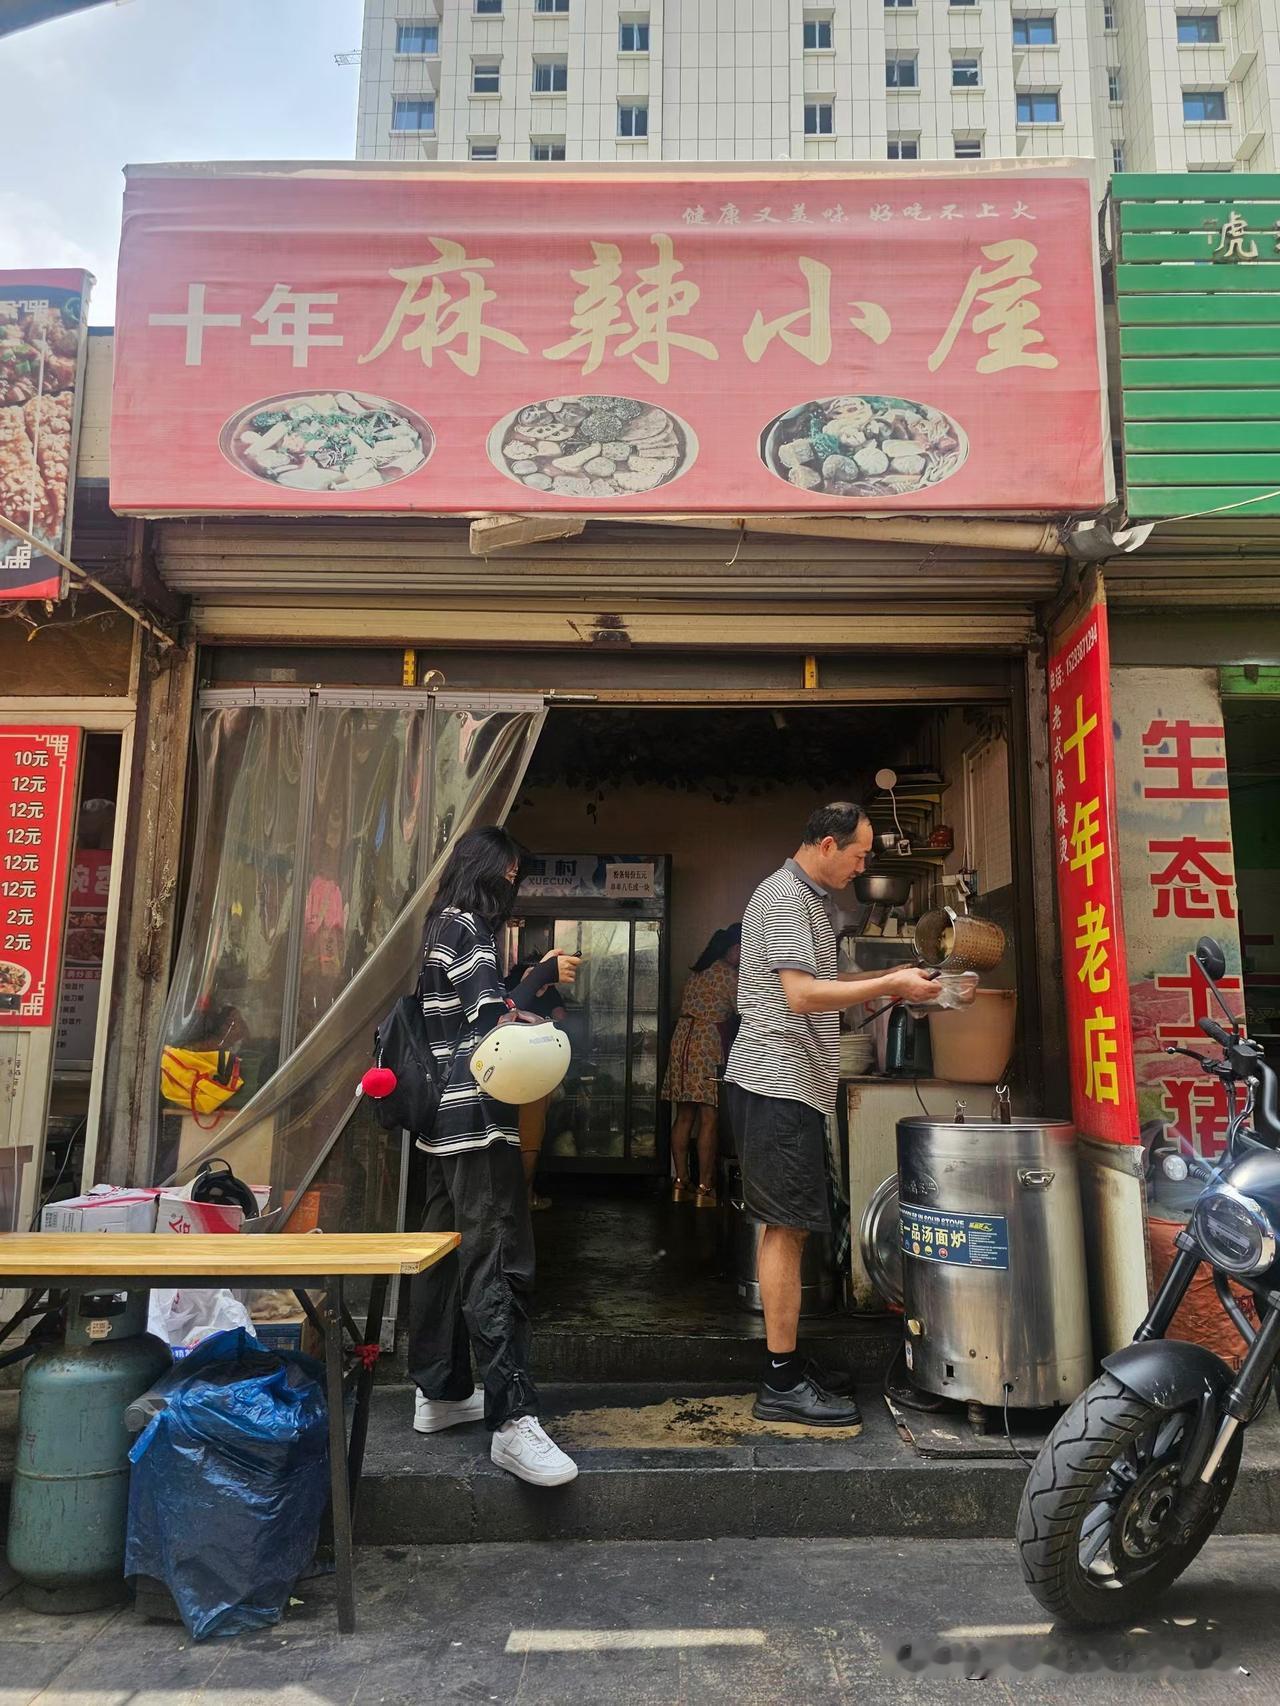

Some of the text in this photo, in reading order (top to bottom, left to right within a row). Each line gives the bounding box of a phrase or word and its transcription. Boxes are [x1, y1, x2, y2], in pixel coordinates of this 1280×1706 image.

[682, 201, 1036, 225] 健康又美味 好吃不上火
[15, 751, 49, 767] 10元
[12, 776, 46, 793] 12元
[1052, 704, 1070, 865] 老式麻辣烫
[9, 802, 44, 819] 12元
[7, 828, 42, 845] 12元
[4, 854, 39, 871] 12元
[1, 880, 37, 898] 12元
[1063, 694, 1120, 1106] 十年老店
[7, 909, 34, 926] 2元
[4, 934, 31, 951] 2元
[903, 1222, 967, 1249] 一品汤面炉
